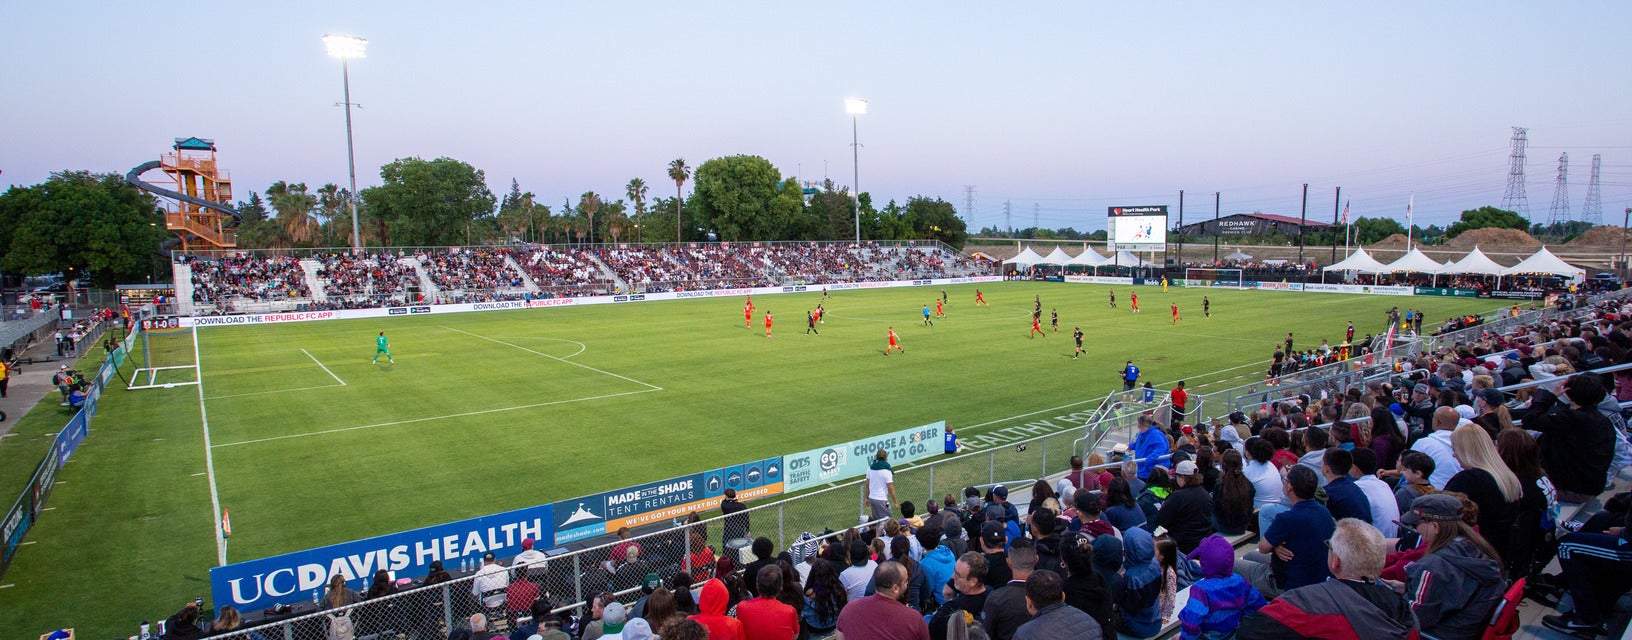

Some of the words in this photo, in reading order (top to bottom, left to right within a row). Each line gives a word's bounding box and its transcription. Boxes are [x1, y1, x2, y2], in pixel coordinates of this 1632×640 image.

[473, 302, 510, 310] DOWNLOAD
[154, 319, 168, 328] 1-0
[194, 316, 244, 326] DOWNLOAD
[247, 315, 263, 323] THE
[264, 313, 304, 322] REPUBLIC
[317, 311, 333, 319] APP
[959, 419, 1064, 451] EALTHY
[854, 437, 897, 456] CHOOSE
[899, 435, 907, 446] A
[893, 448, 906, 460] TO
[909, 443, 927, 456] GO.
[789, 456, 810, 470] OTS
[790, 470, 811, 478] TRAFFIC
[790, 476, 810, 484] SAFETY
[608, 490, 641, 506] MADE
[658, 479, 693, 496] SHADE
[609, 502, 639, 517] TENT
[645, 491, 694, 509] RENTALS
[625, 515, 649, 526] WE'VE
[651, 511, 666, 519] GOT
[667, 507, 686, 516] YOUR
[688, 502, 706, 512] NEXT
[740, 488, 769, 499] COVERED
[556, 527, 605, 541] madeshade.com
[228, 568, 296, 605] UC
[299, 544, 411, 591] DAVIS
[414, 517, 543, 567] HEALTH
